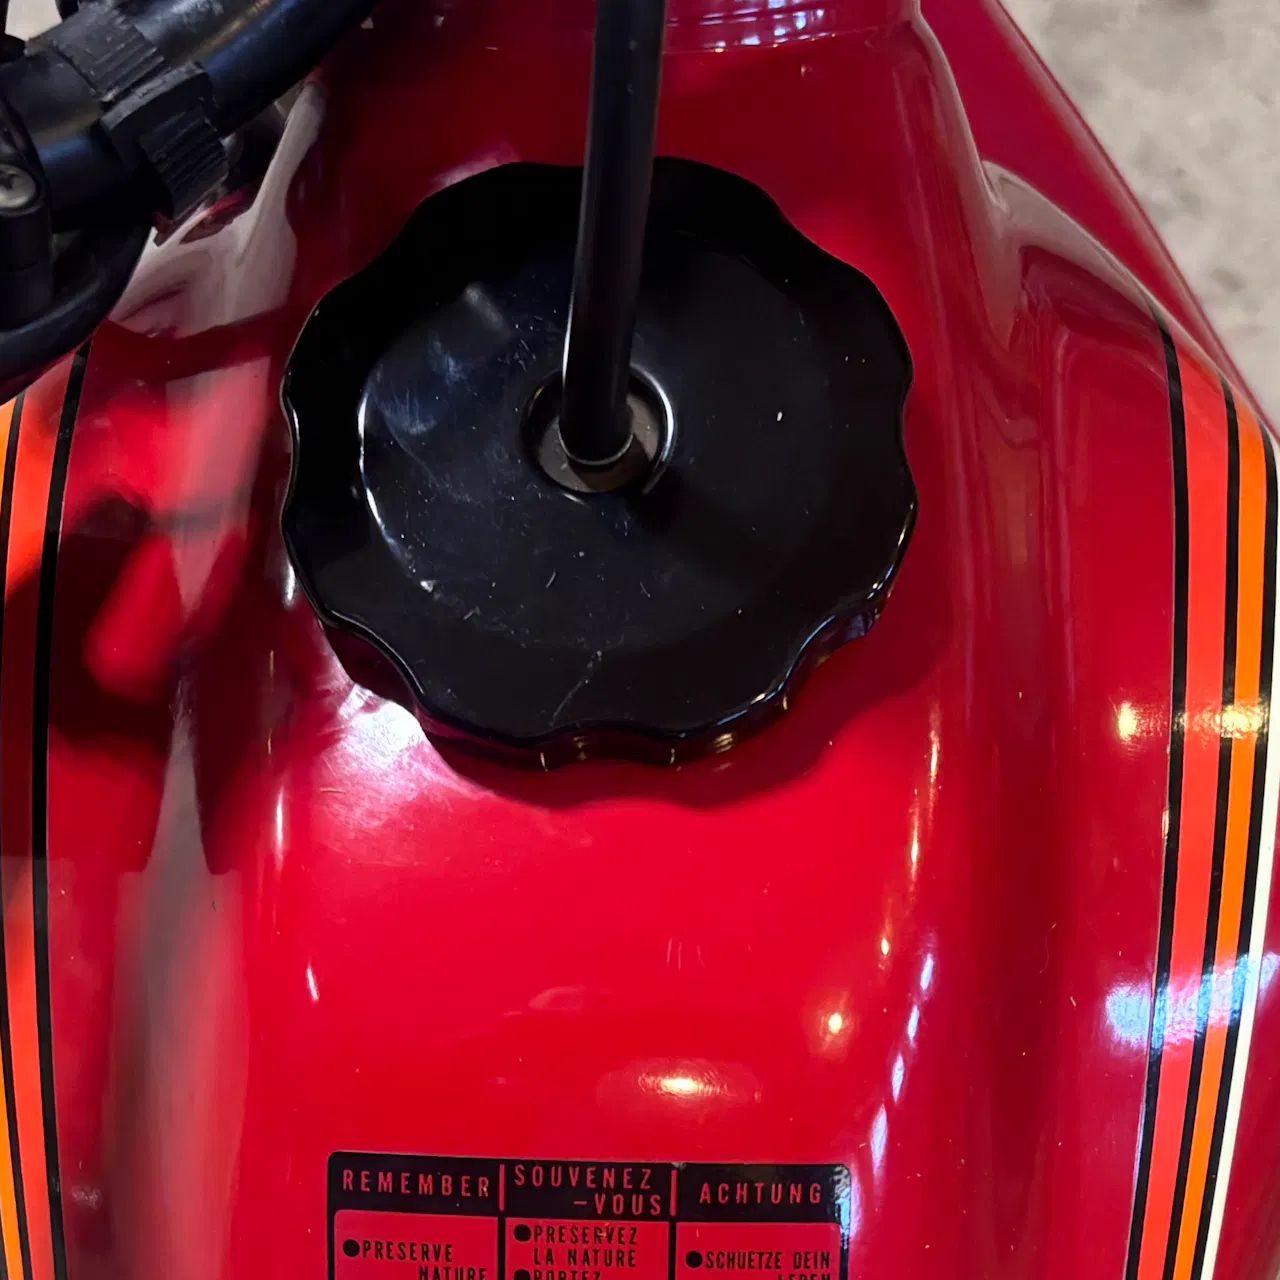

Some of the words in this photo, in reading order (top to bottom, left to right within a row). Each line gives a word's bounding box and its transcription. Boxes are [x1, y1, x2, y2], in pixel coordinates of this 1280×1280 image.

[343, 1169, 489, 1197] REMEMBER
[515, 1164, 651, 1189] SOUVENEZ
[700, 1183, 822, 1204] ACHTUNG
[534, 1225, 637, 1246] PRESERVEZ
[363, 1240, 452, 1262] PRESERVE
[534, 1248, 554, 1266] LA
[568, 1249, 636, 1268] NATURE
[706, 1251, 782, 1270] SCHUETZE
[793, 1251, 830, 1270] DEIN
